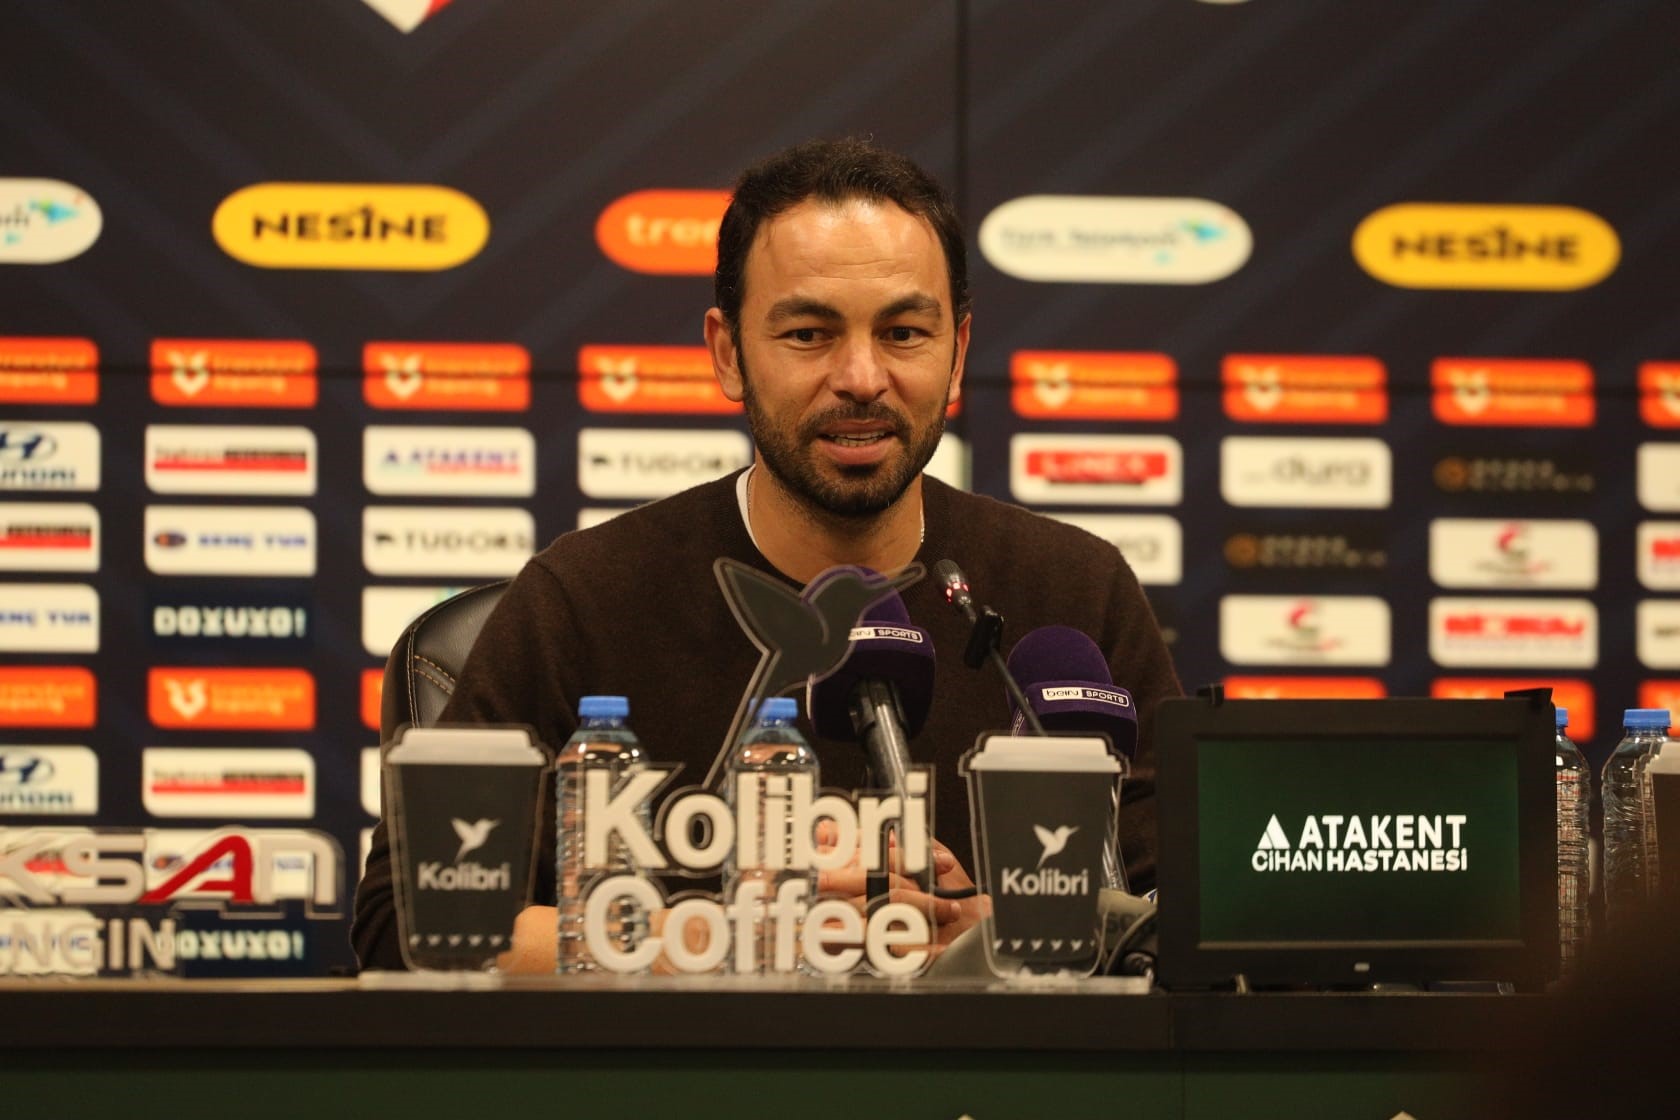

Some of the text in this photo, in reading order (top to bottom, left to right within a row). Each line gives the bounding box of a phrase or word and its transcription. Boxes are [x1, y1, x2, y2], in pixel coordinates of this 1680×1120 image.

[153, 605, 306, 638] DOXUXO!
[877, 628, 919, 641] SPORTS
[1085, 689, 1125, 704] SPORTS
[584, 767, 930, 873] Kolibri
[1299, 814, 1468, 849] ATAKENT
[417, 861, 511, 890] Kolibri
[1001, 866, 1089, 896] Kolibri
[583, 874, 930, 976] Coffee
